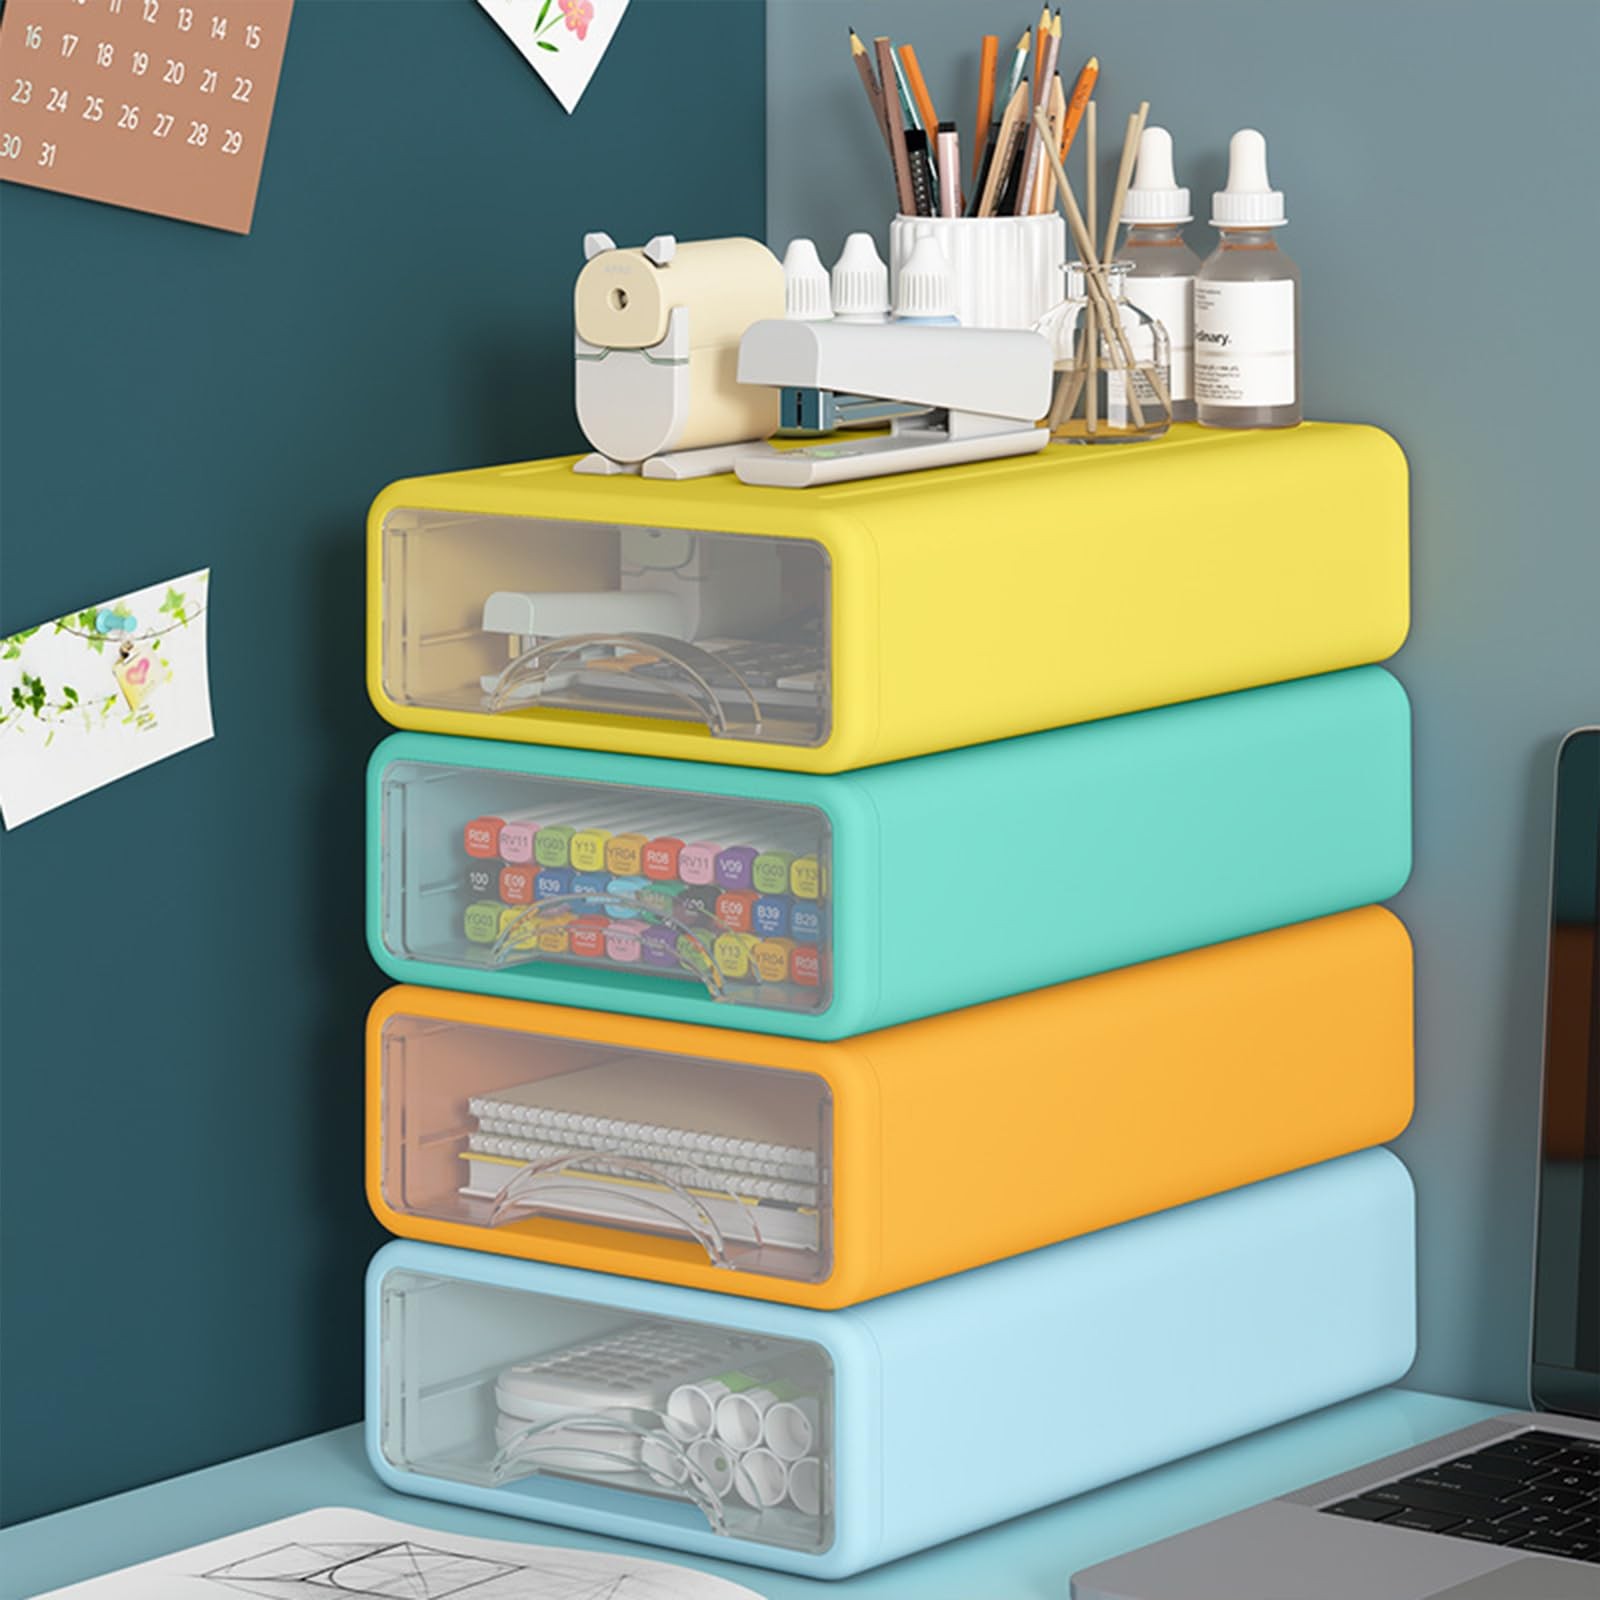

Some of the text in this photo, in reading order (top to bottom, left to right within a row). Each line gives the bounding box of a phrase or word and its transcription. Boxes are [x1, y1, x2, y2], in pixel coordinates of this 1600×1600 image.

[143, 0, 160, 24] 12
[177, 7, 194, 32] 13
[210, 15, 228, 41] 14
[245, 24, 262, 49] 15
[25, 24, 253, 103] 16 17 18 19 20 21 22
[10, 78, 243, 155] 23 24 25 26 27 28 29
[0, 133, 57, 168] 30 31
[647, 850, 670, 864] R08
[719, 859, 743, 873] V09
[469, 872, 489, 885] 100
[504, 873, 526, 888] E09
[538, 877, 561, 892] B39
[720, 901, 743, 915] E09
[757, 905, 780, 919] B39
[794, 913, 818, 927] B29
